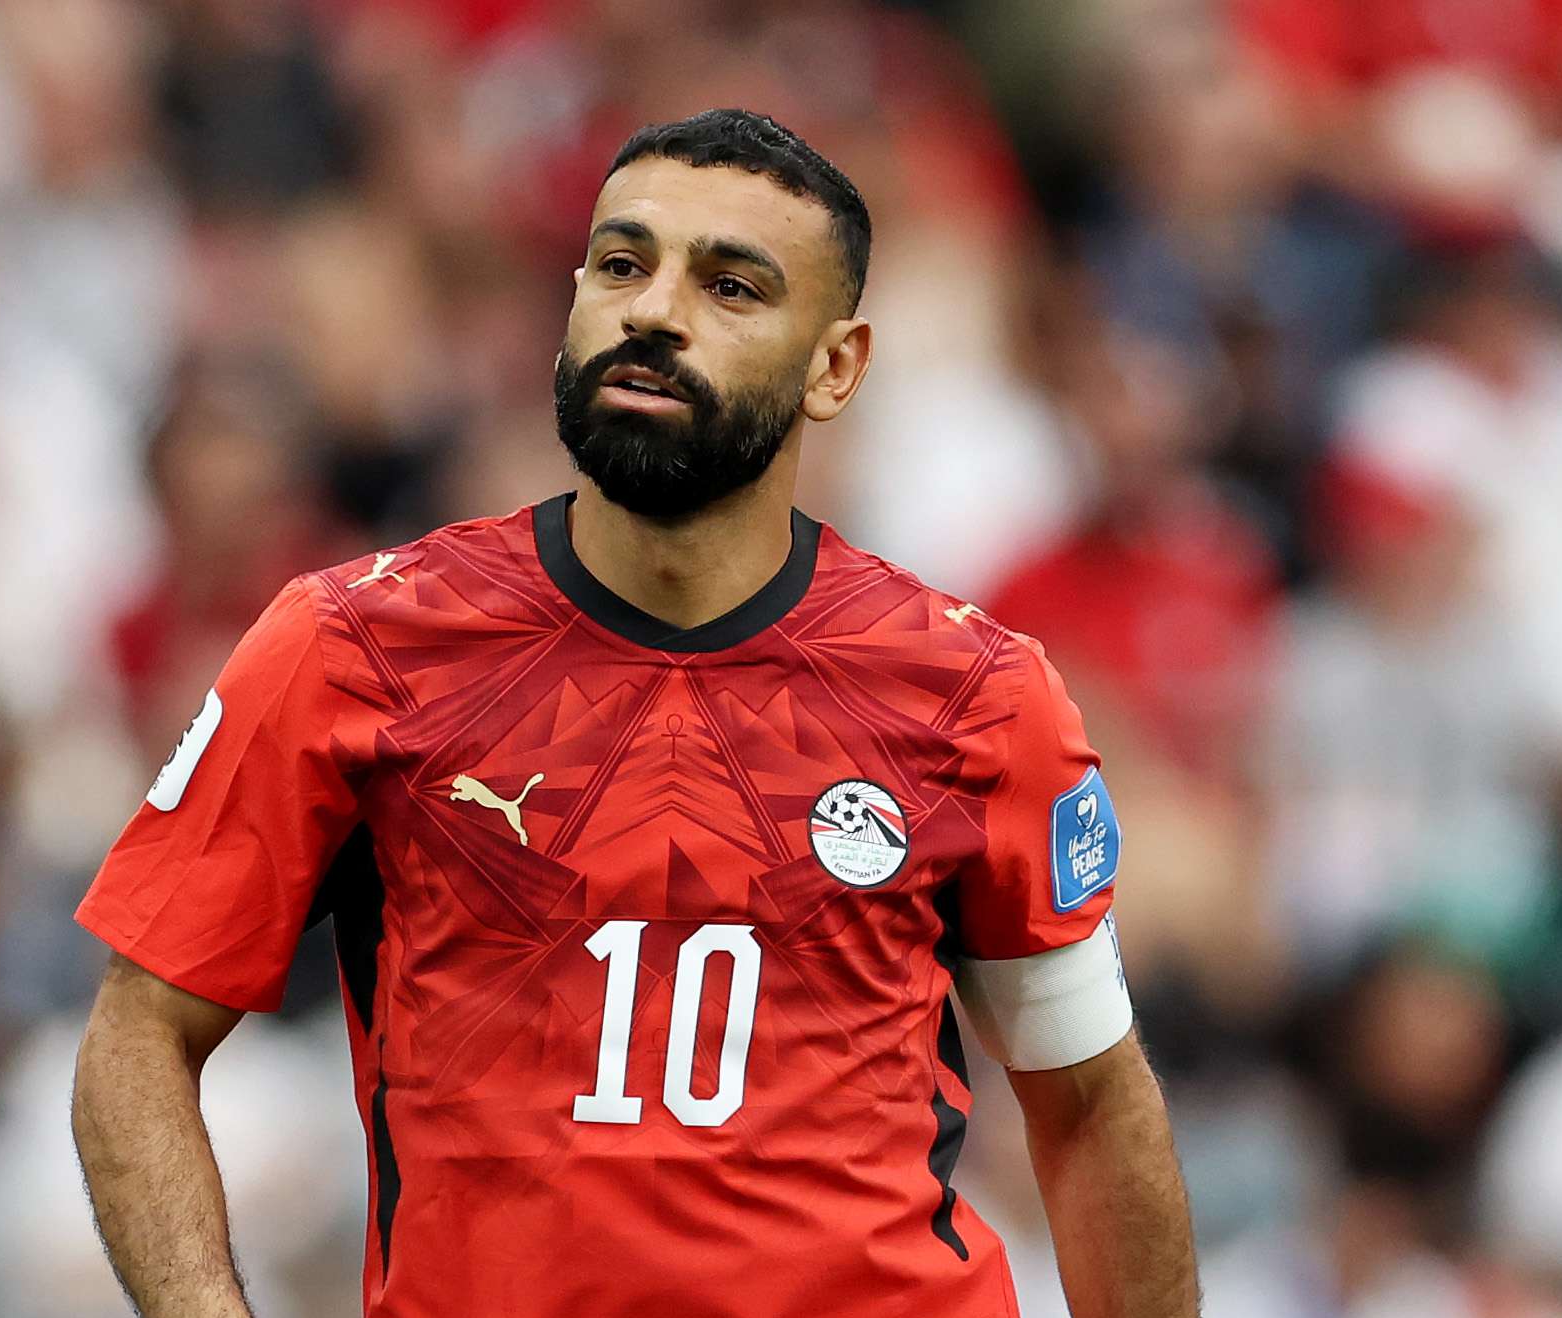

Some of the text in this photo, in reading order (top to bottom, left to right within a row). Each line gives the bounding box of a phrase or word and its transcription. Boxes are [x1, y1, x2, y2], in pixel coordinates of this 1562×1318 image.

[834, 862, 871, 879] EGYPTIAN
[1072, 842, 1105, 880] PEACE
[1082, 870, 1100, 889] FIFA
[573, 920, 762, 1127] 10
